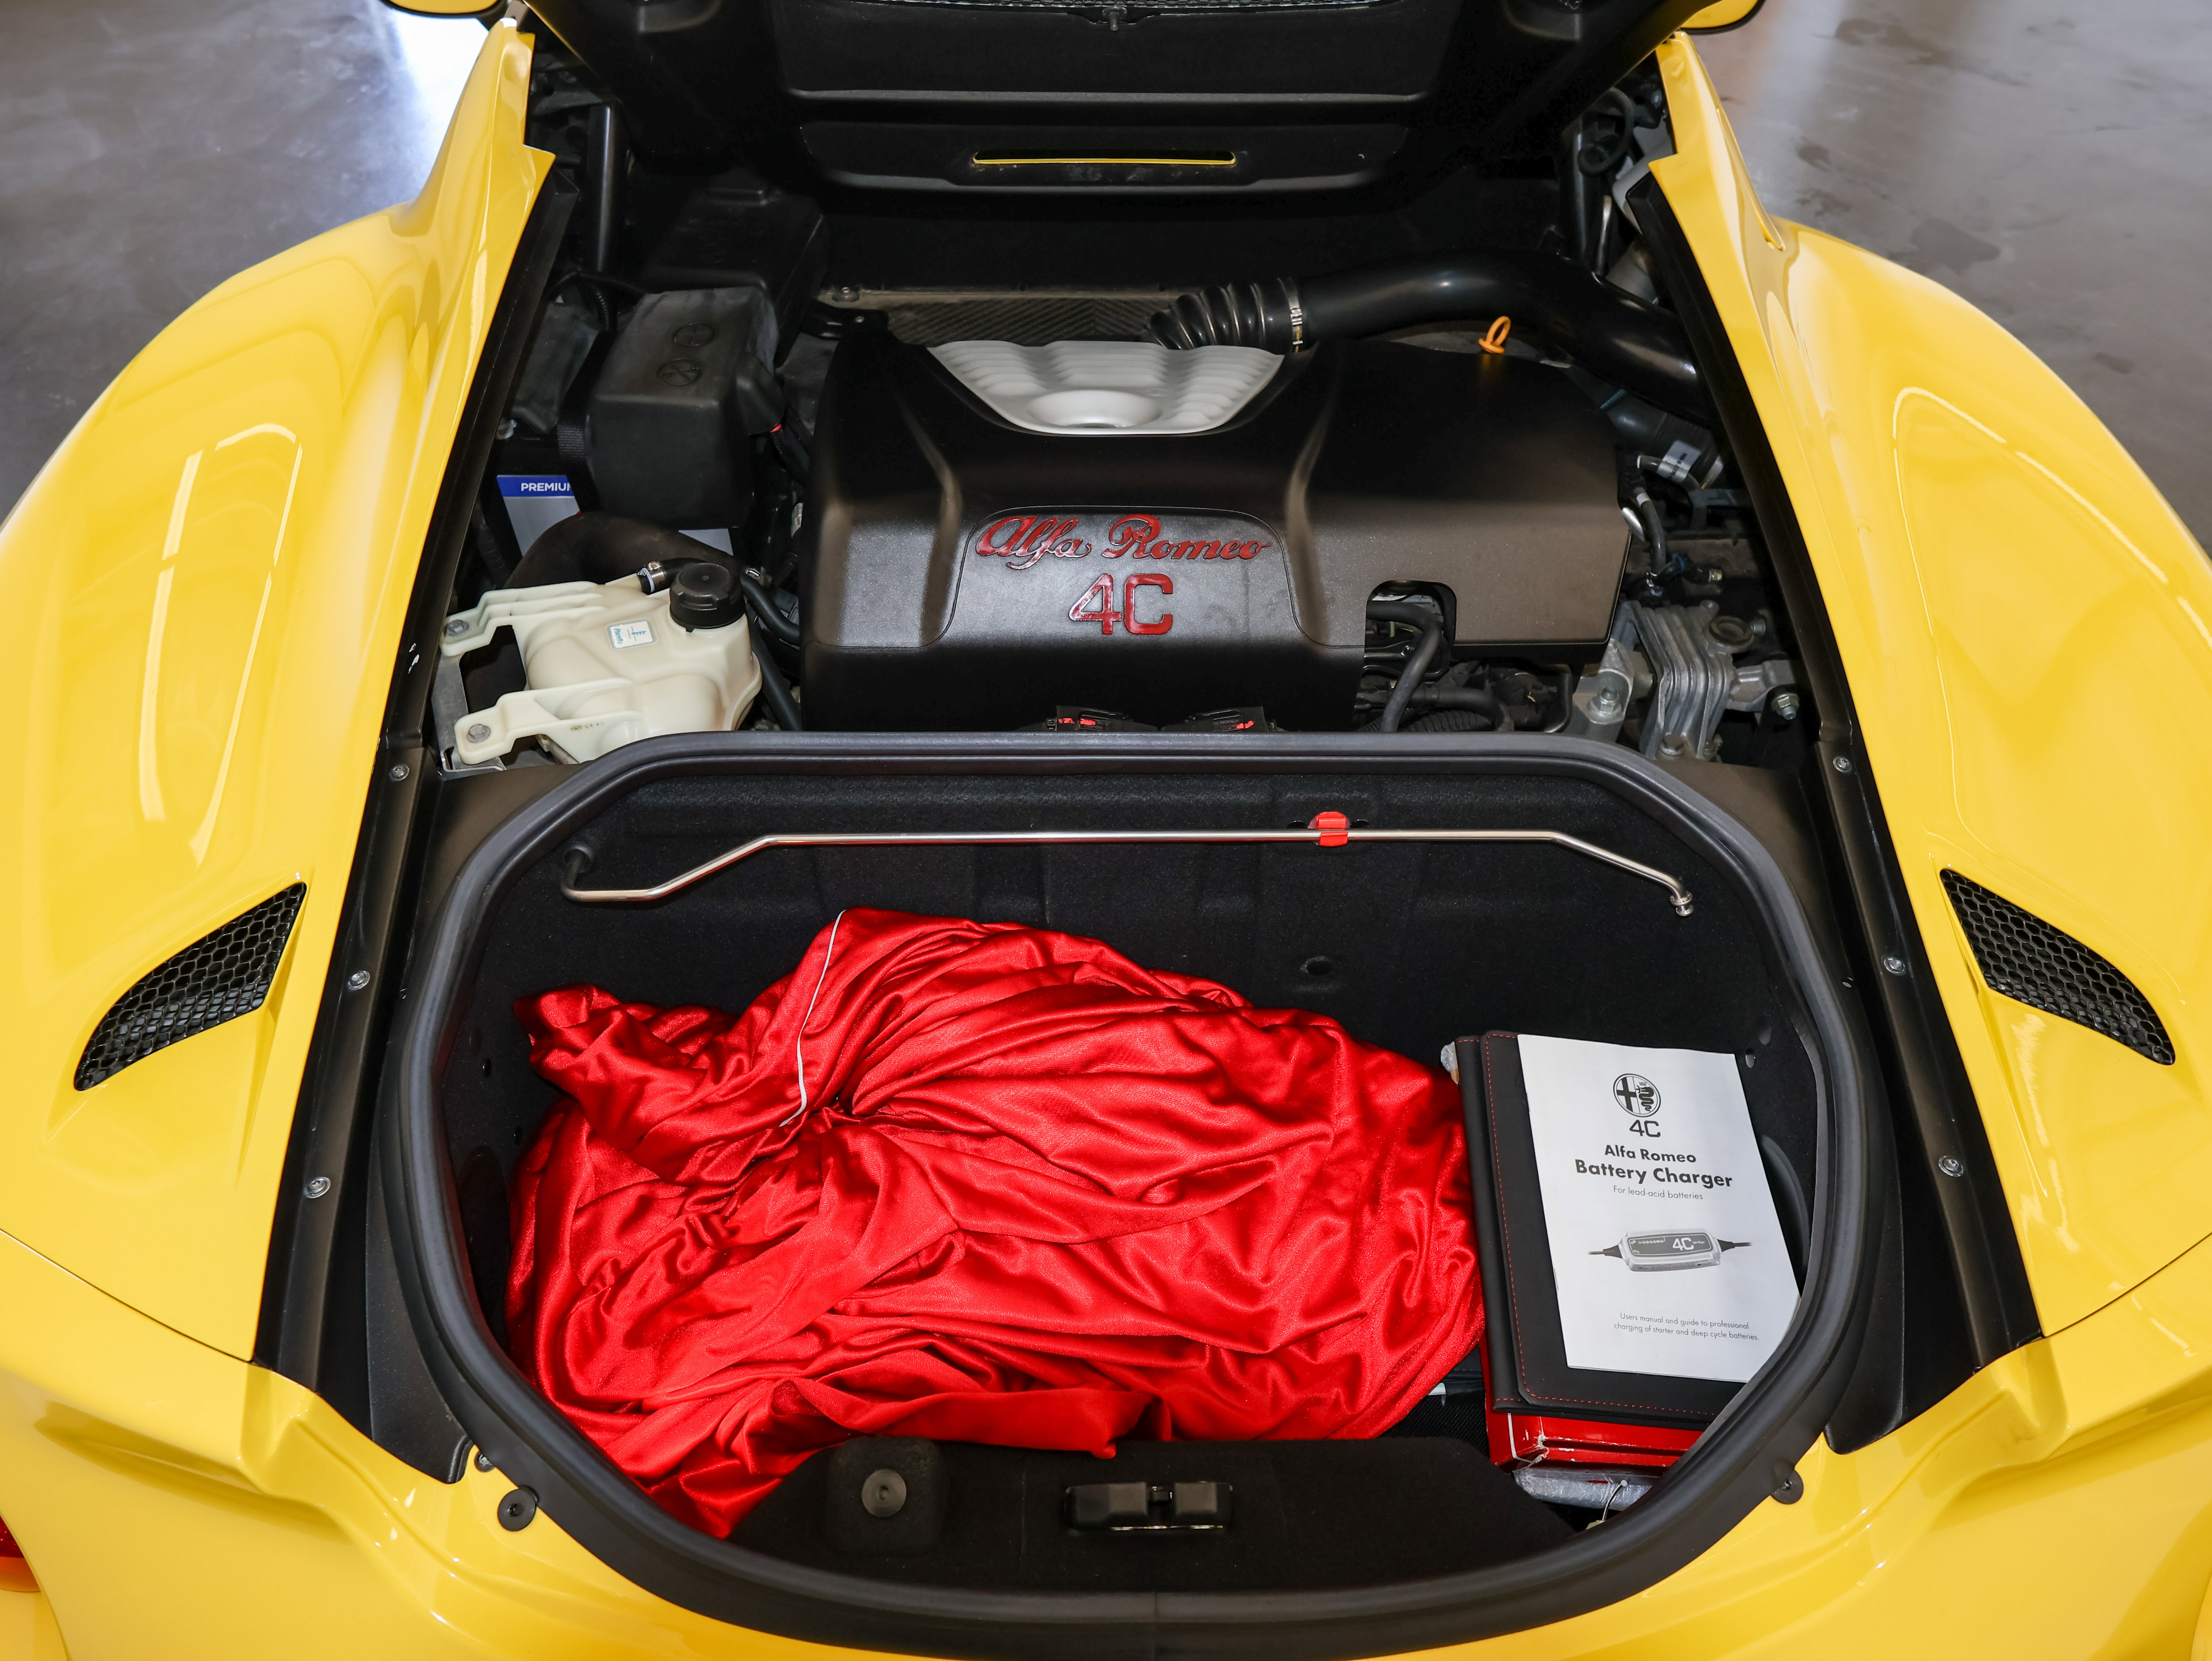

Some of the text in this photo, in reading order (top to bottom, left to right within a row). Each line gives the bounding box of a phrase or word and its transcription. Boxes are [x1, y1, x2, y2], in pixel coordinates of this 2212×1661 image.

[976, 513, 1272, 569] Alfa Romeo
[1069, 573, 1174, 635] 4C
[1629, 1120, 1661, 1137] 4C
[1605, 1144, 1696, 1163] Alfa Romeo
[1575, 1159, 1732, 1189] Battery Charger
[1614, 1186, 1703, 1200] For lead-acid batteries
[1672, 1237, 1694, 1251] 4C
[1614, 1322, 1643, 1333] charging
[1691, 1330, 1708, 1338] deep
[1710, 1330, 1727, 1339] cycle
[1729, 1332, 1759, 1340] batteries.
[1681, 1318, 1699, 1327] guide
[1710, 1320, 1749, 1330] professional
